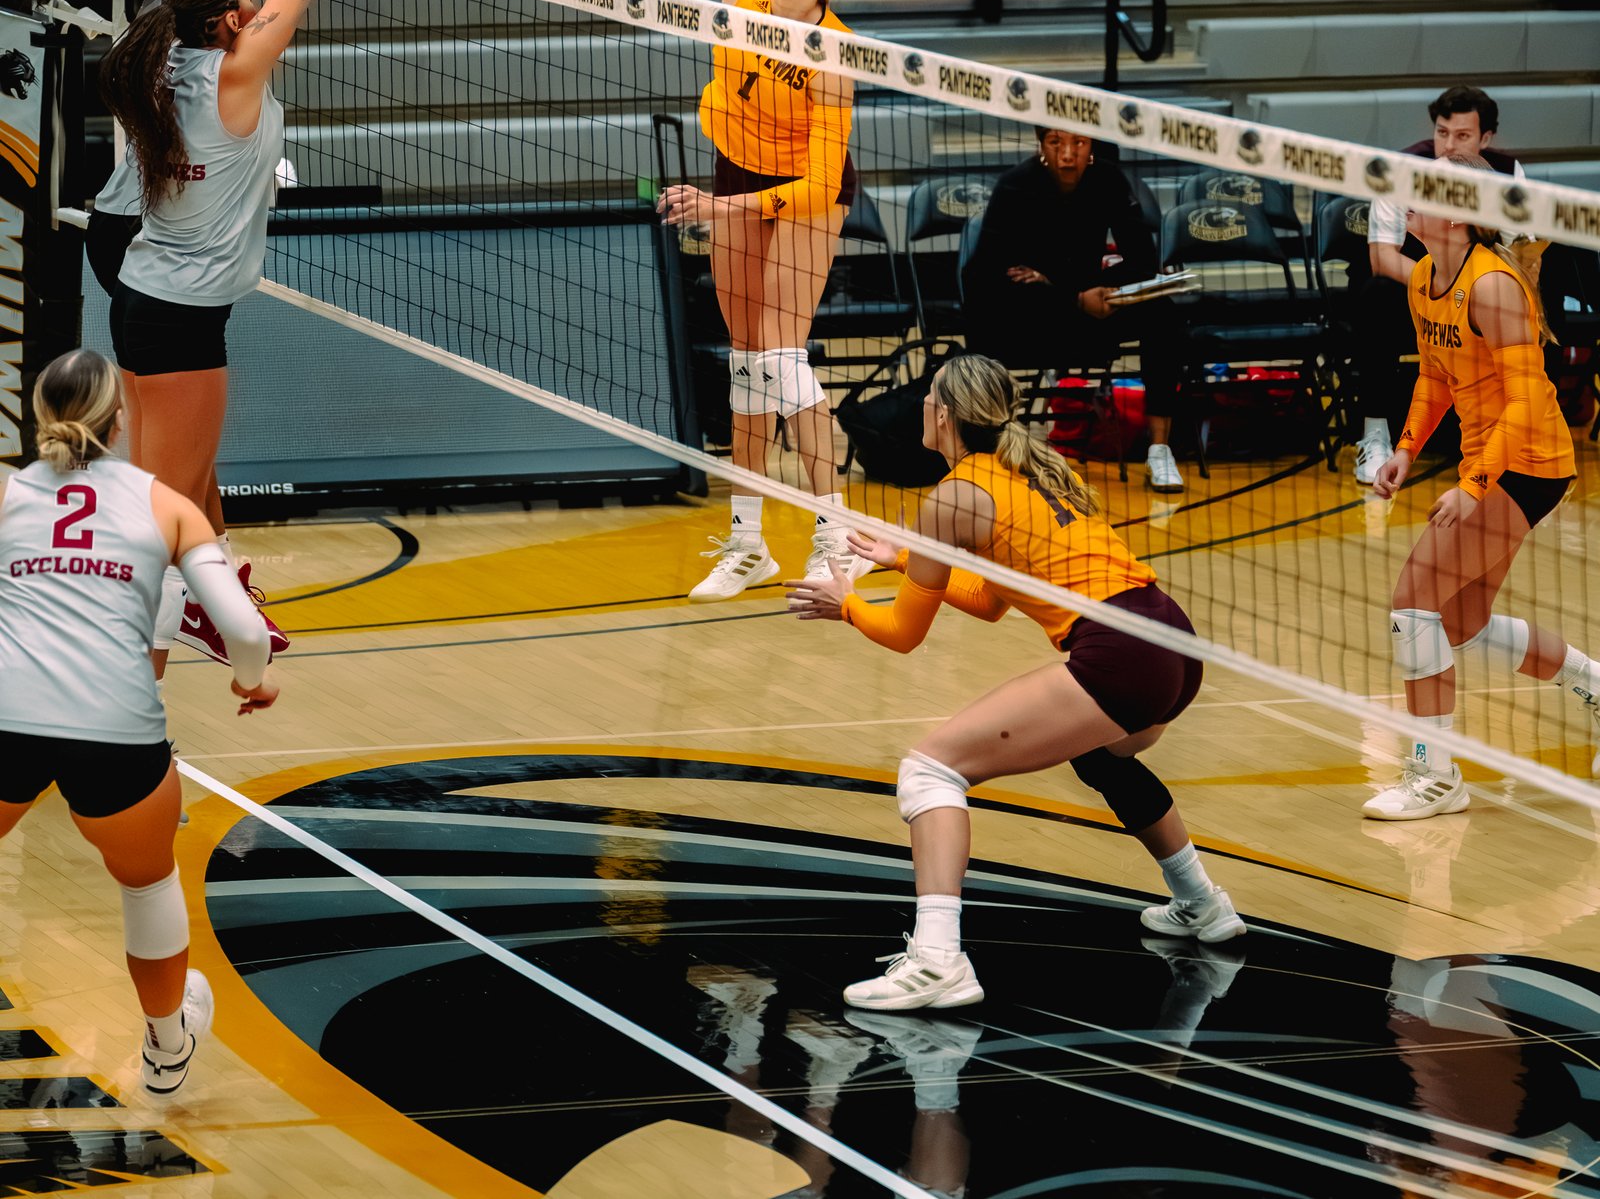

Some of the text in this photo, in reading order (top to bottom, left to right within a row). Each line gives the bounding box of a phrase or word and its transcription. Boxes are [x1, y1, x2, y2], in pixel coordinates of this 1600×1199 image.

[656, 0, 700, 32] PANTHERS
[745, 19, 790, 54] PANTHERS
[838, 41, 889, 77] PANTHERS
[938, 65, 992, 102] PANTHERS
[1046, 90, 1102, 127] PANTHERS
[1160, 116, 1219, 155] PANTHERS
[1282, 141, 1346, 182] PANTHERS
[737, 71, 759, 102] 1
[218, 483, 294, 497] TRONICS
[52, 484, 97, 550] 2
[10, 556, 134, 583] CYCLONES
